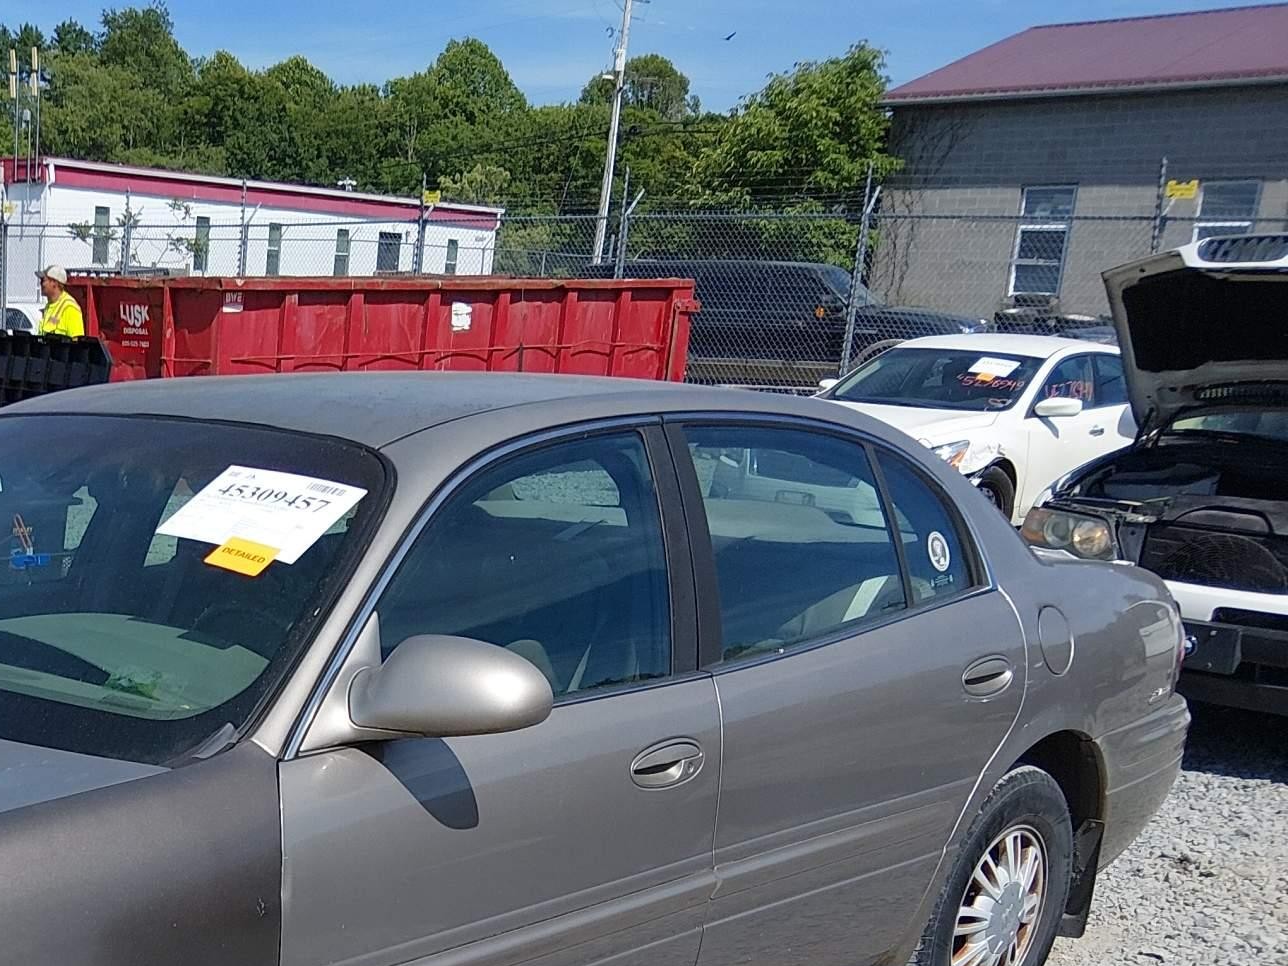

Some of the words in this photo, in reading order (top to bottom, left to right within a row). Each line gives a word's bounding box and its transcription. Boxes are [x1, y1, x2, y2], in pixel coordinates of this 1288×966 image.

[120, 303, 150, 327] LUSK
[218, 484, 332, 512] 45309457
[222, 547, 266, 564] DETAILED
